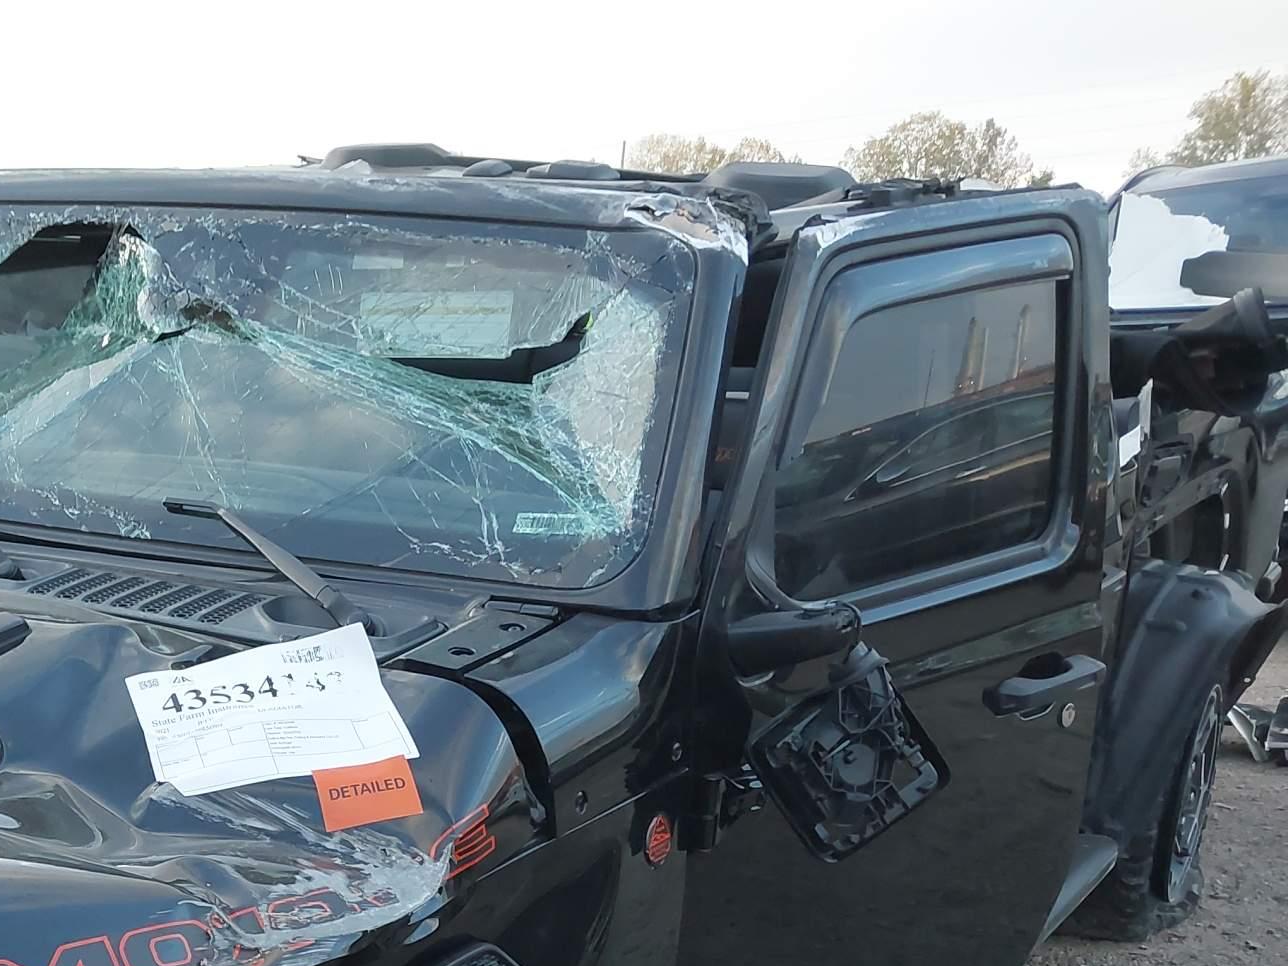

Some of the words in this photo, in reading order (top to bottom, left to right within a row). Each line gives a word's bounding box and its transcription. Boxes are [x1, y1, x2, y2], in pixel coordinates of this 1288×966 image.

[152, 717, 176, 728] State
[179, 711, 207, 721] Farm
[328, 777, 406, 801] DETAILED
